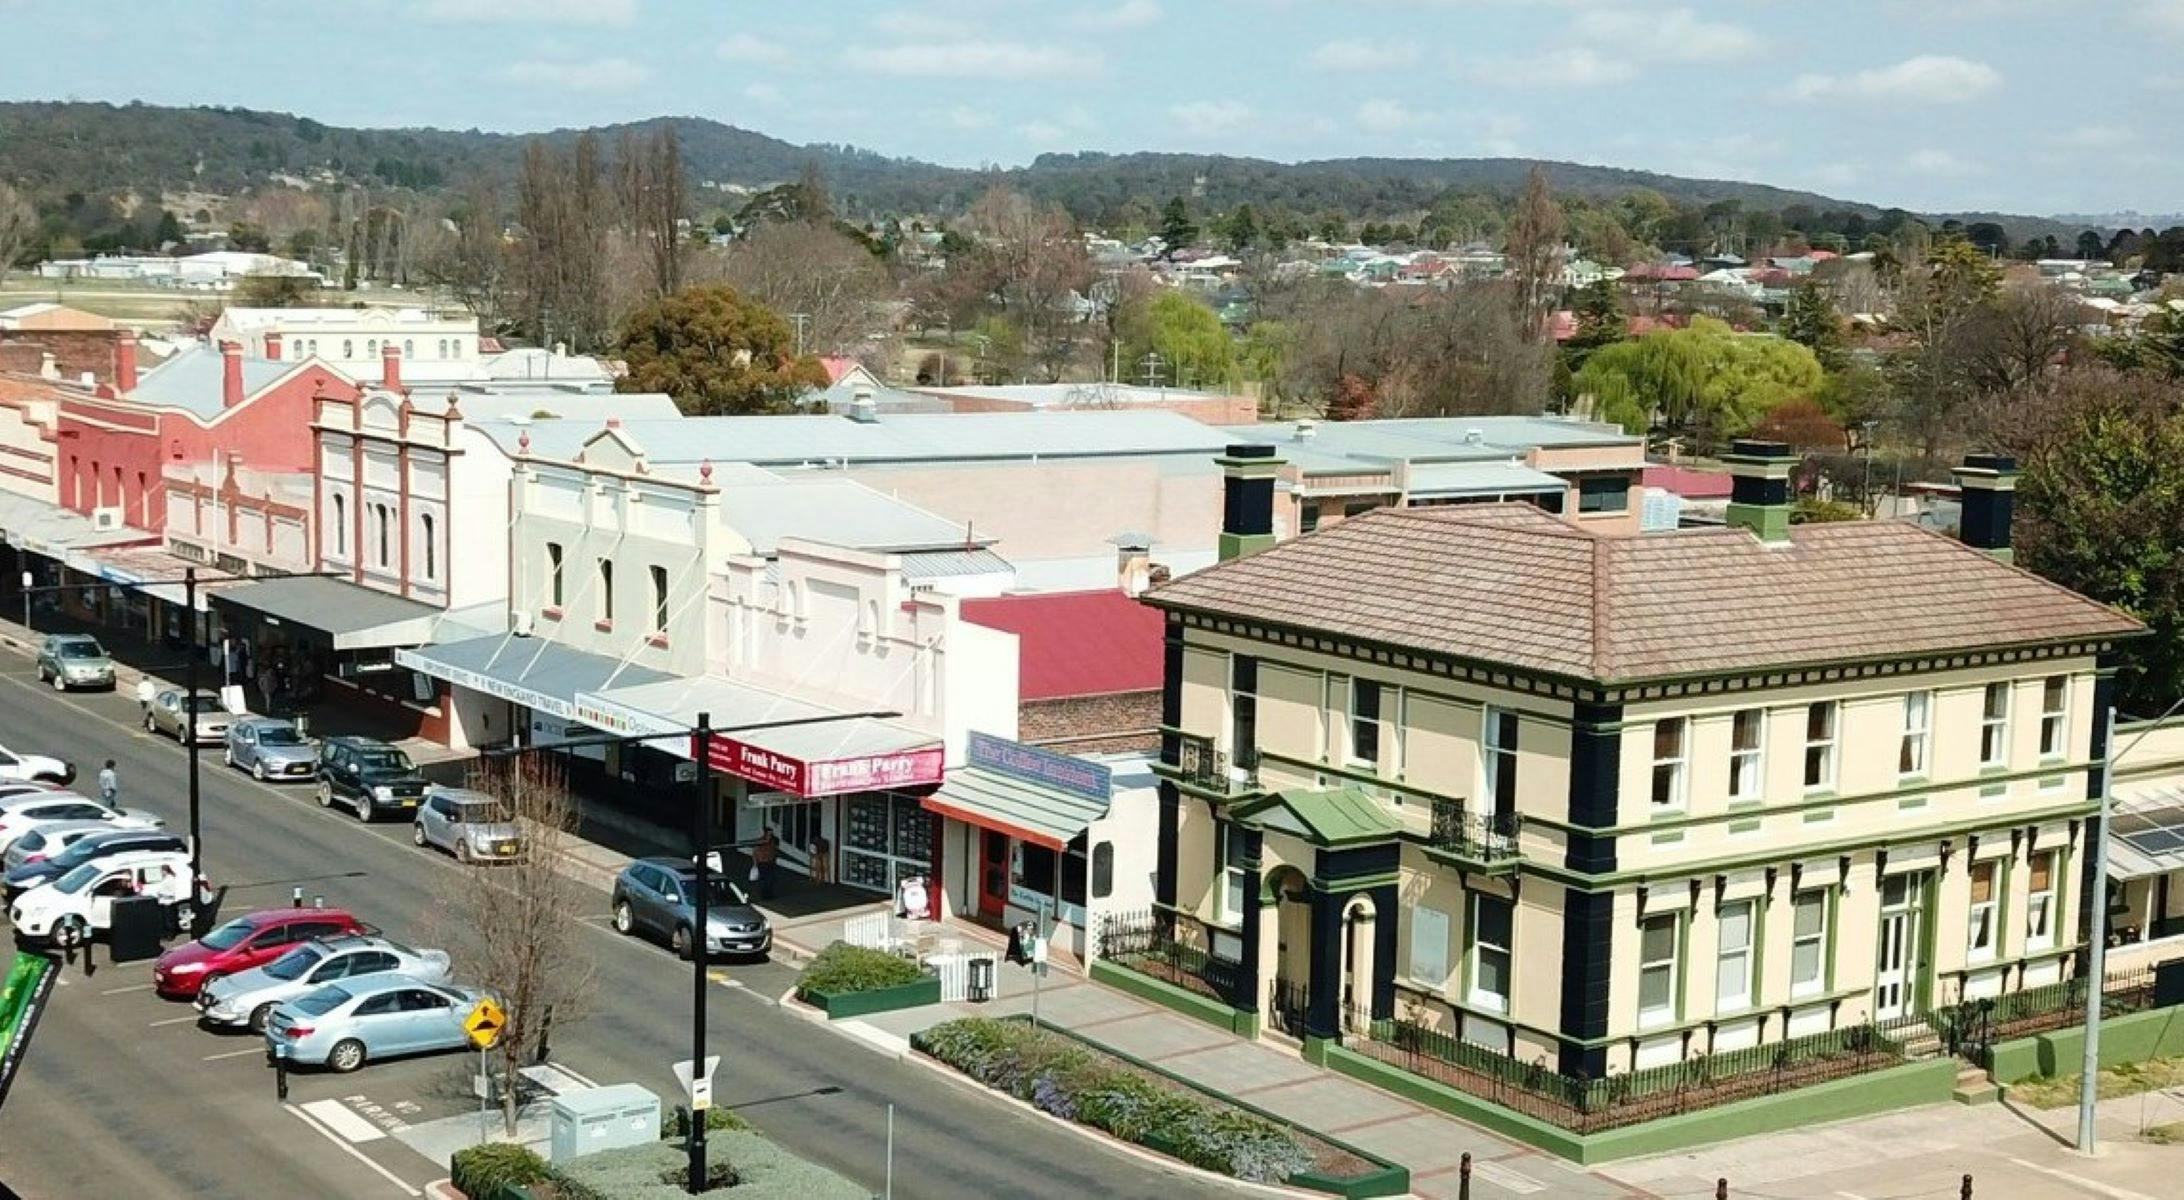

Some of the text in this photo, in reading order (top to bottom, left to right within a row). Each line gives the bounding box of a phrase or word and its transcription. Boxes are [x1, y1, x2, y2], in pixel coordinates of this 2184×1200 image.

[740, 745, 768, 768] Frank
[770, 755, 797, 780] Parry
[823, 756, 914, 778] Frank Parry
